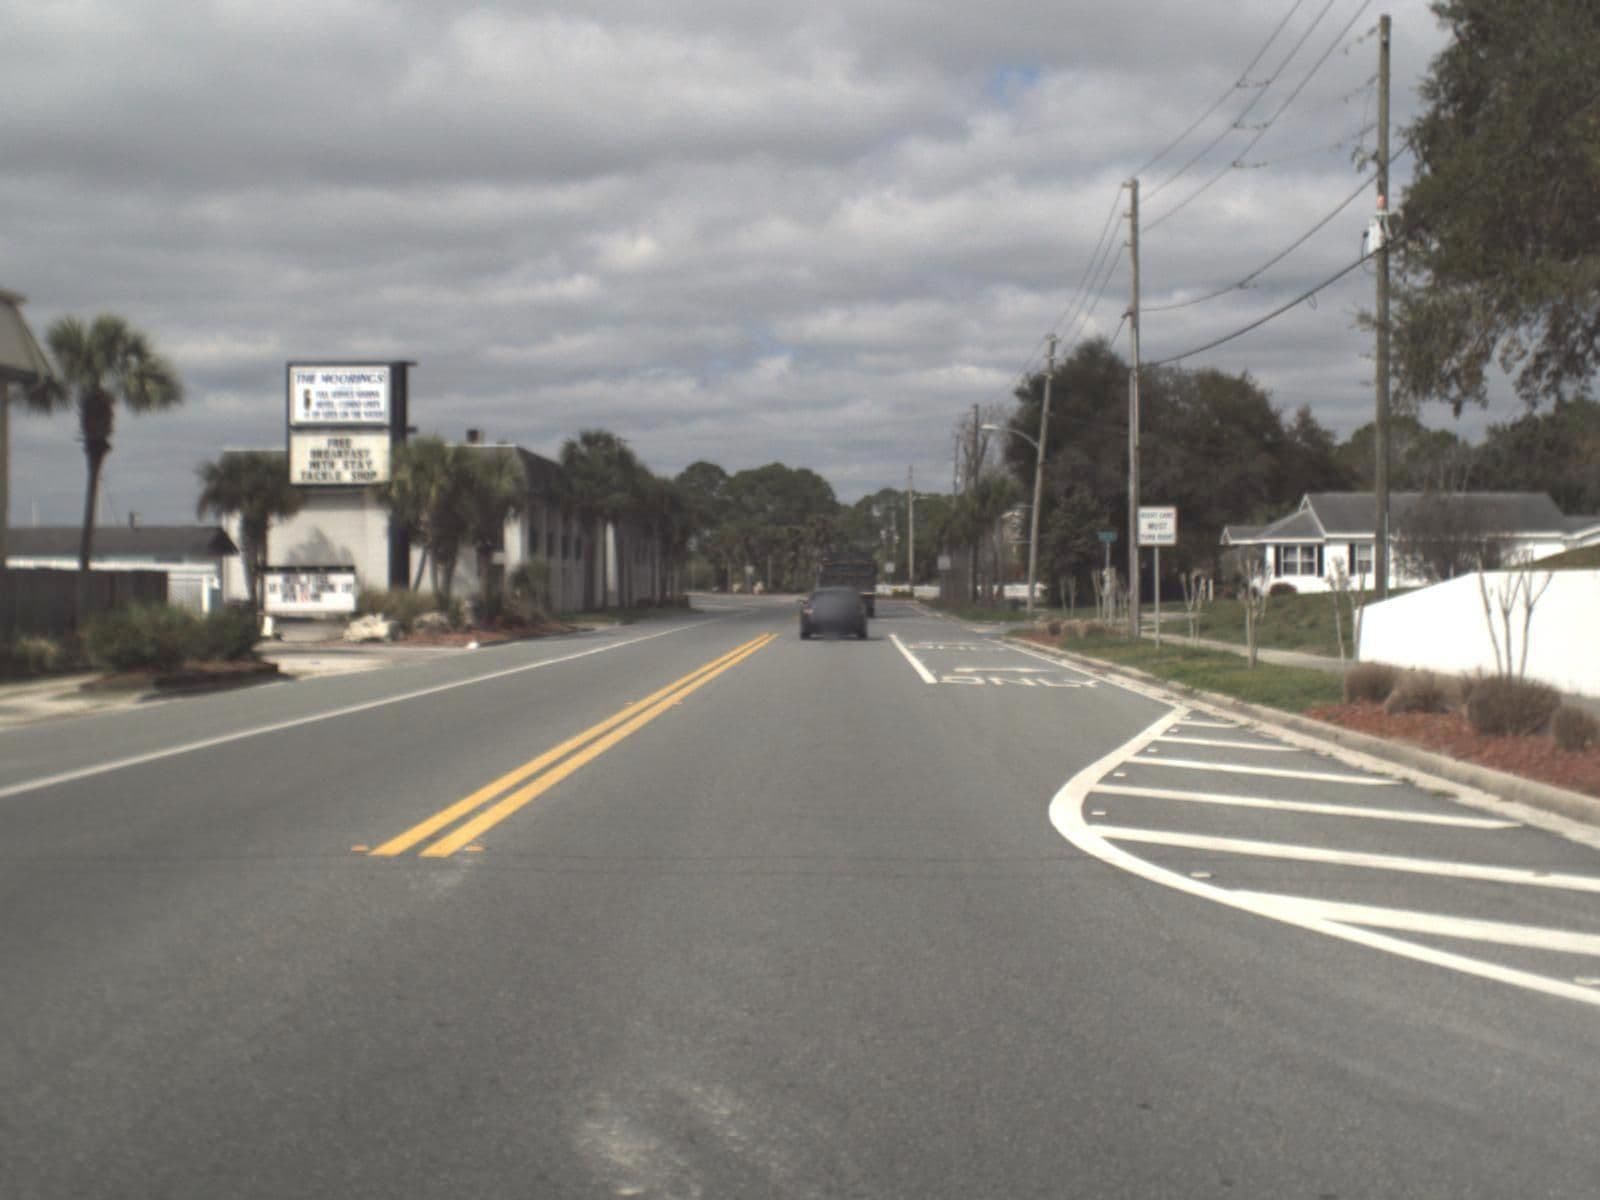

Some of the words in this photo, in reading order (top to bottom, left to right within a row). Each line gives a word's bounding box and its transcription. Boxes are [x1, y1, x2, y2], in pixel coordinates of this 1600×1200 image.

[296, 374, 315, 384] THE
[321, 373, 384, 384] MOORINGS
[328, 438, 351, 448] FREE
[310, 450, 370, 459] BREAKFAST
[343, 461, 372, 470] STAY
[352, 471, 377, 481] SHOP
[1148, 522, 1168, 530] MUST
[940, 676, 1098, 688] ONLY
